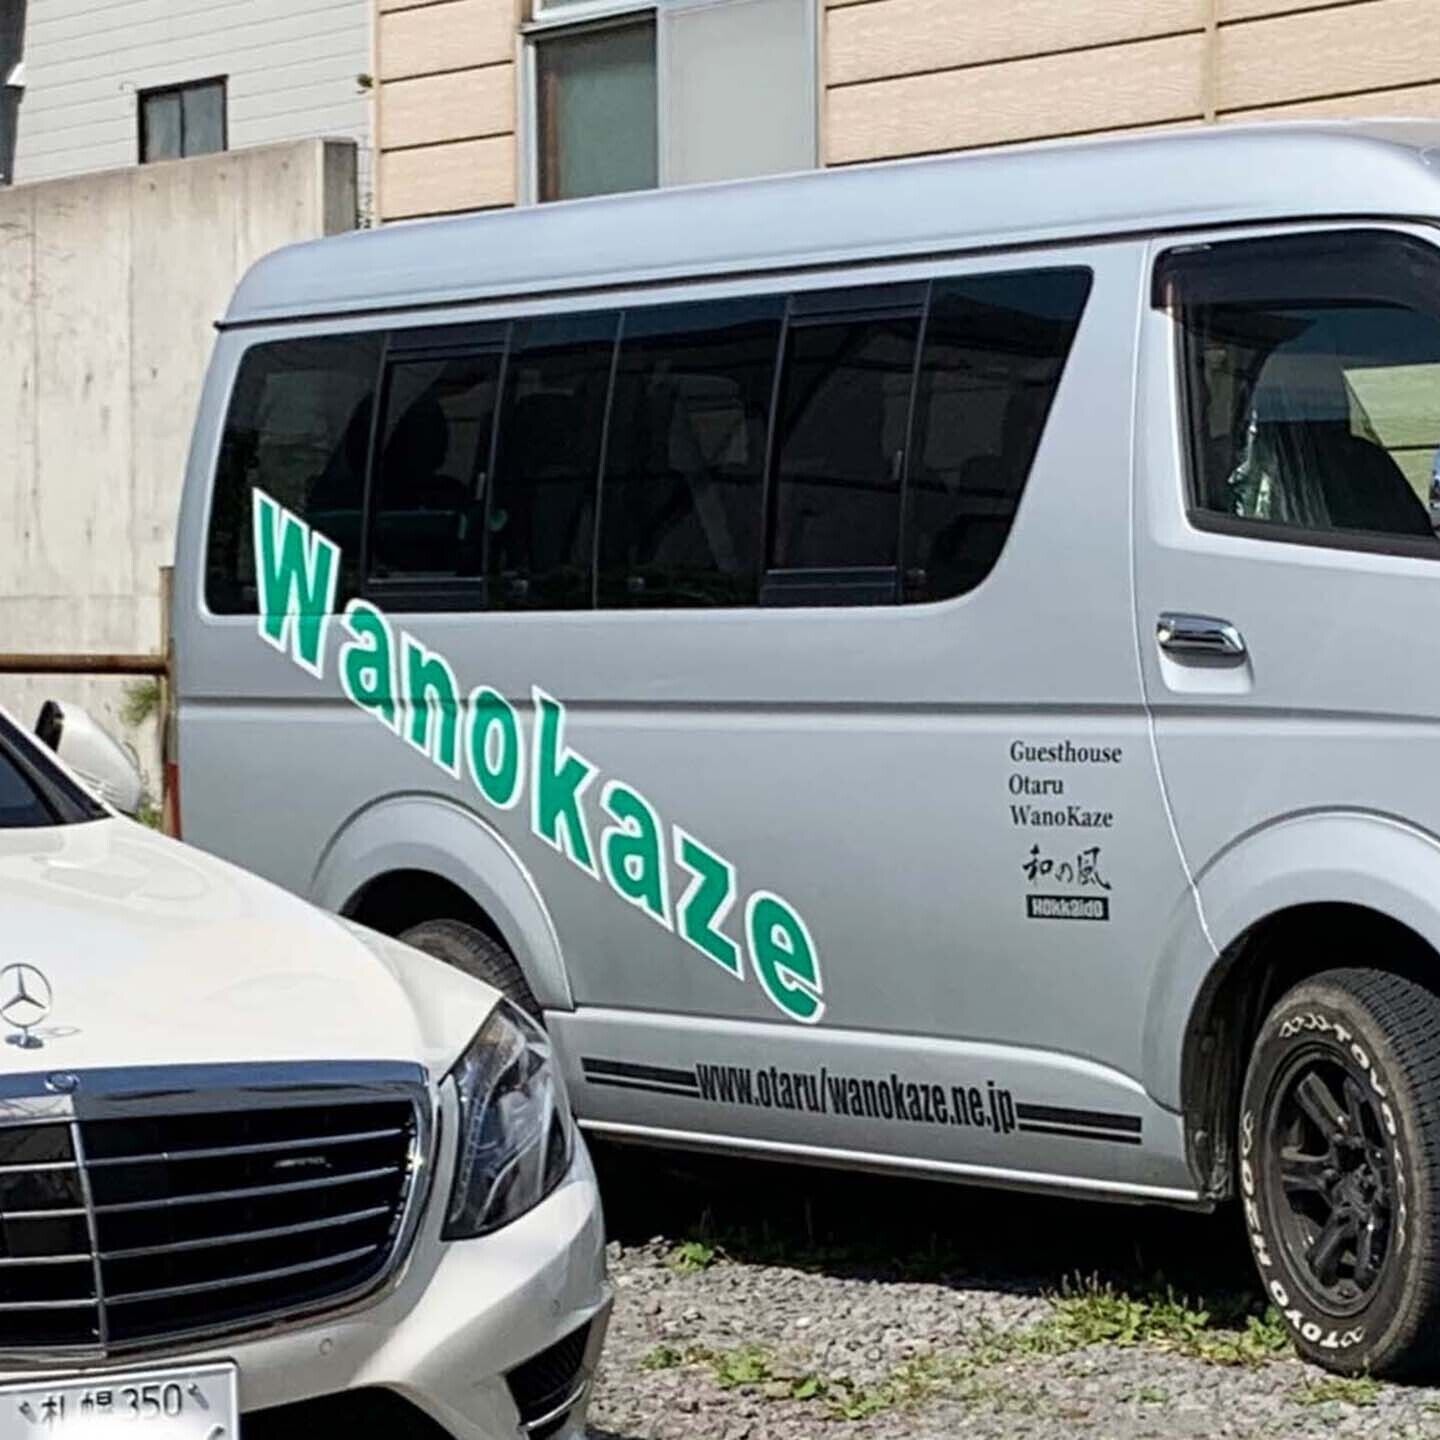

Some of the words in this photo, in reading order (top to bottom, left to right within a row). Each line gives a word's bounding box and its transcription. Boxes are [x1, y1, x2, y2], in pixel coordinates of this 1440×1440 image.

[252, 488, 826, 1025] Wanokaze
[1010, 740, 1122, 763] Guesthouse
[1009, 774, 1063, 795] Otaru
[1010, 804, 1113, 828] WanoKaze
[1023, 844, 1112, 890] 和の風
[696, 1063, 1017, 1134] www.otaru/wanokaze.ne.jp
[1270, 1280, 1339, 1349] TOYO
